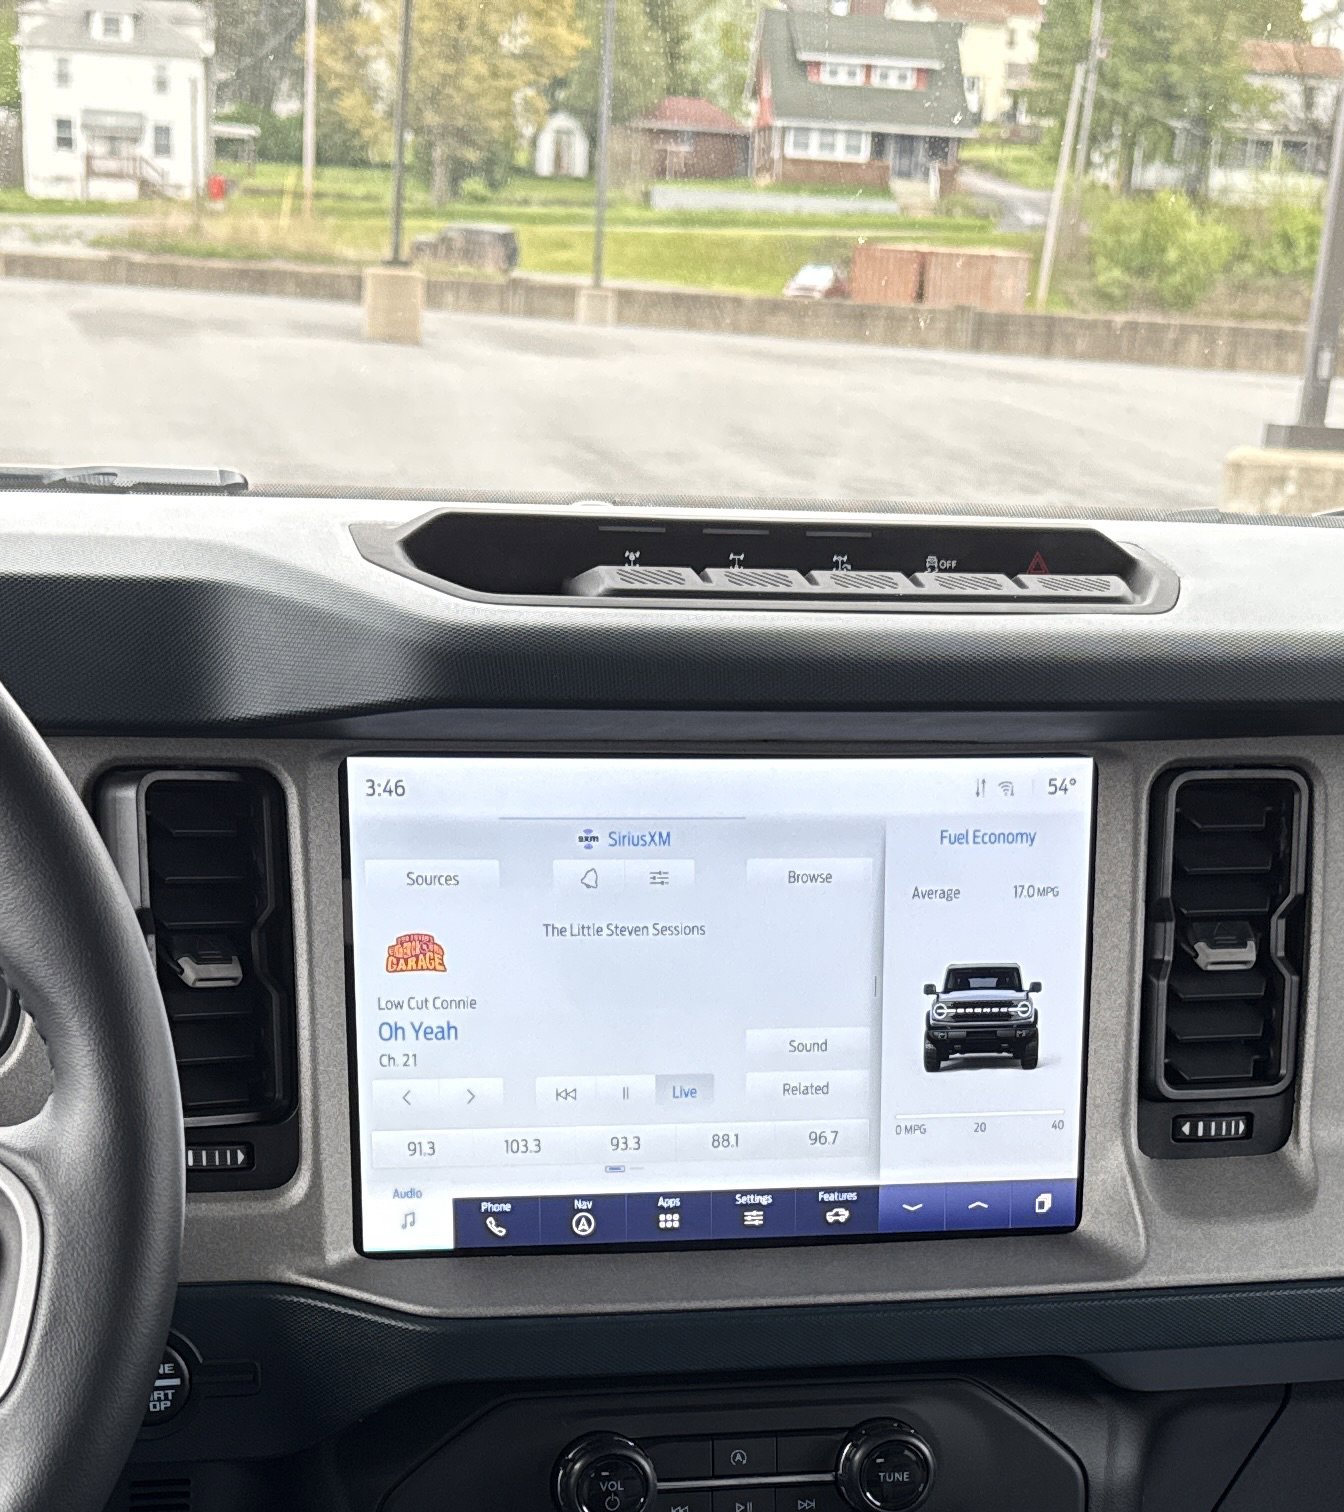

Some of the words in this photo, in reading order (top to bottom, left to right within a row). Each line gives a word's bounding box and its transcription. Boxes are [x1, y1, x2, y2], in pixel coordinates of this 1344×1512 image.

[939, 560, 957, 570] OFF
[365, 778, 406, 797] 3:46
[608, 830, 672, 847] SiriusXM
[940, 829, 970, 846] Fuel
[972, 830, 1037, 848] Economy
[406, 871, 460, 887] Sources
[788, 870, 833, 885] Browse
[912, 886, 961, 902] Average
[1013, 884, 1036, 899] 17.0
[1037, 886, 1060, 898] MPG
[543, 923, 568, 938] The
[569, 923, 604, 937] Little
[606, 922, 650, 937] Steven
[652, 922, 706, 937] Sessions
[386, 952, 447, 972] GARAGE
[377, 997, 404, 1010] Low
[407, 997, 430, 1010] Cut
[432, 996, 477, 1010] Connie
[378, 1021, 406, 1042] Oh
[410, 1020, 458, 1041] Yeah
[788, 1038, 828, 1053] Sound
[379, 1053, 399, 1067] Ch.
[402, 1053, 418, 1067] 21
[672, 1085, 698, 1099] Live
[782, 1081, 829, 1097] Related
[895, 1124, 902, 1135] 0
[904, 1123, 927, 1135] MPG
[973, 1121, 987, 1133] 20
[1051, 1119, 1065, 1131] 40
[407, 1141, 436, 1157] 91.3
[503, 1138, 542, 1154] 103.3
[610, 1136, 641, 1151] 93.3
[711, 1133, 740, 1149] 88.1
[808, 1130, 839, 1146] 96.7
[392, 1187, 422, 1199] Audio
[735, 1193, 773, 1206] Settings
[818, 1191, 857, 1202] Features
[480, 1201, 511, 1213] Phone
[574, 1198, 593, 1210] Nav
[657, 1196, 681, 1209] Apps
[878, 1470, 910, 1483] TUNE
[600, 1480, 625, 1491] VOL
